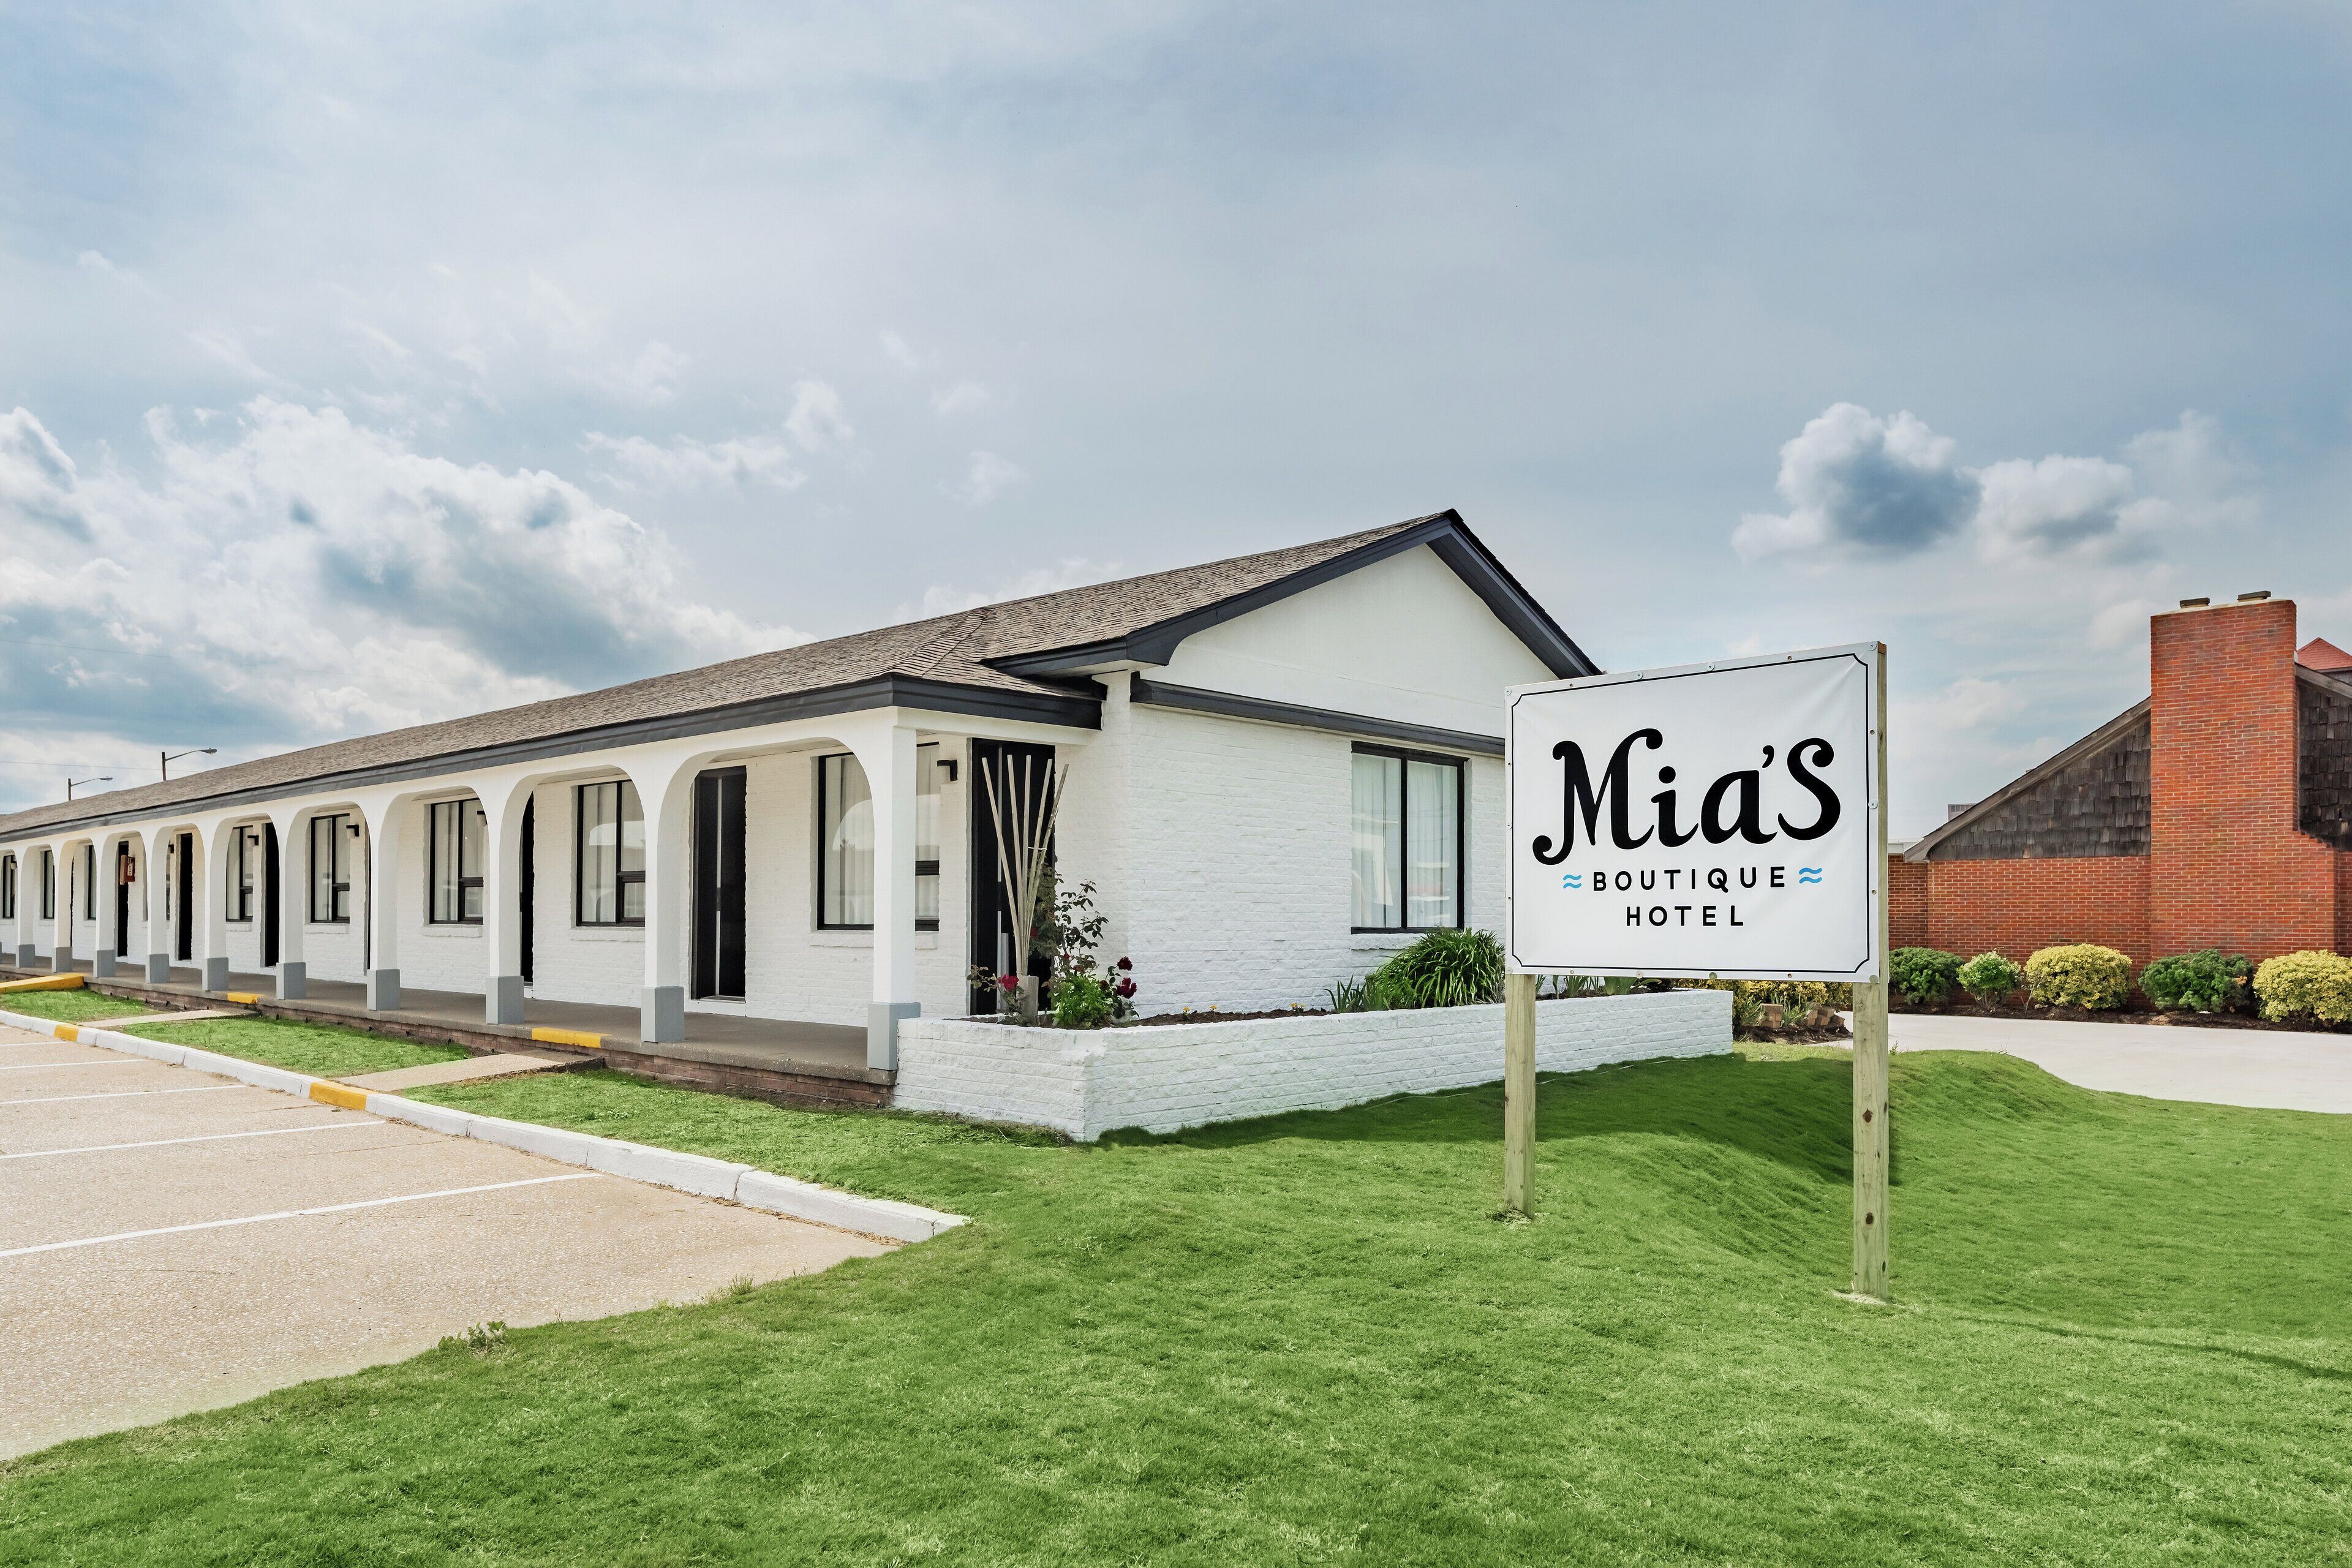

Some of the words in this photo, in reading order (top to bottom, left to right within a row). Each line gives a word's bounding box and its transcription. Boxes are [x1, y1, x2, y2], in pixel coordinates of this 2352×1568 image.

[1532, 728, 1841, 865] Mia'S
[1593, 865, 1785, 894] BOUTIQUE
[1626, 905, 1744, 927] HOTEL
